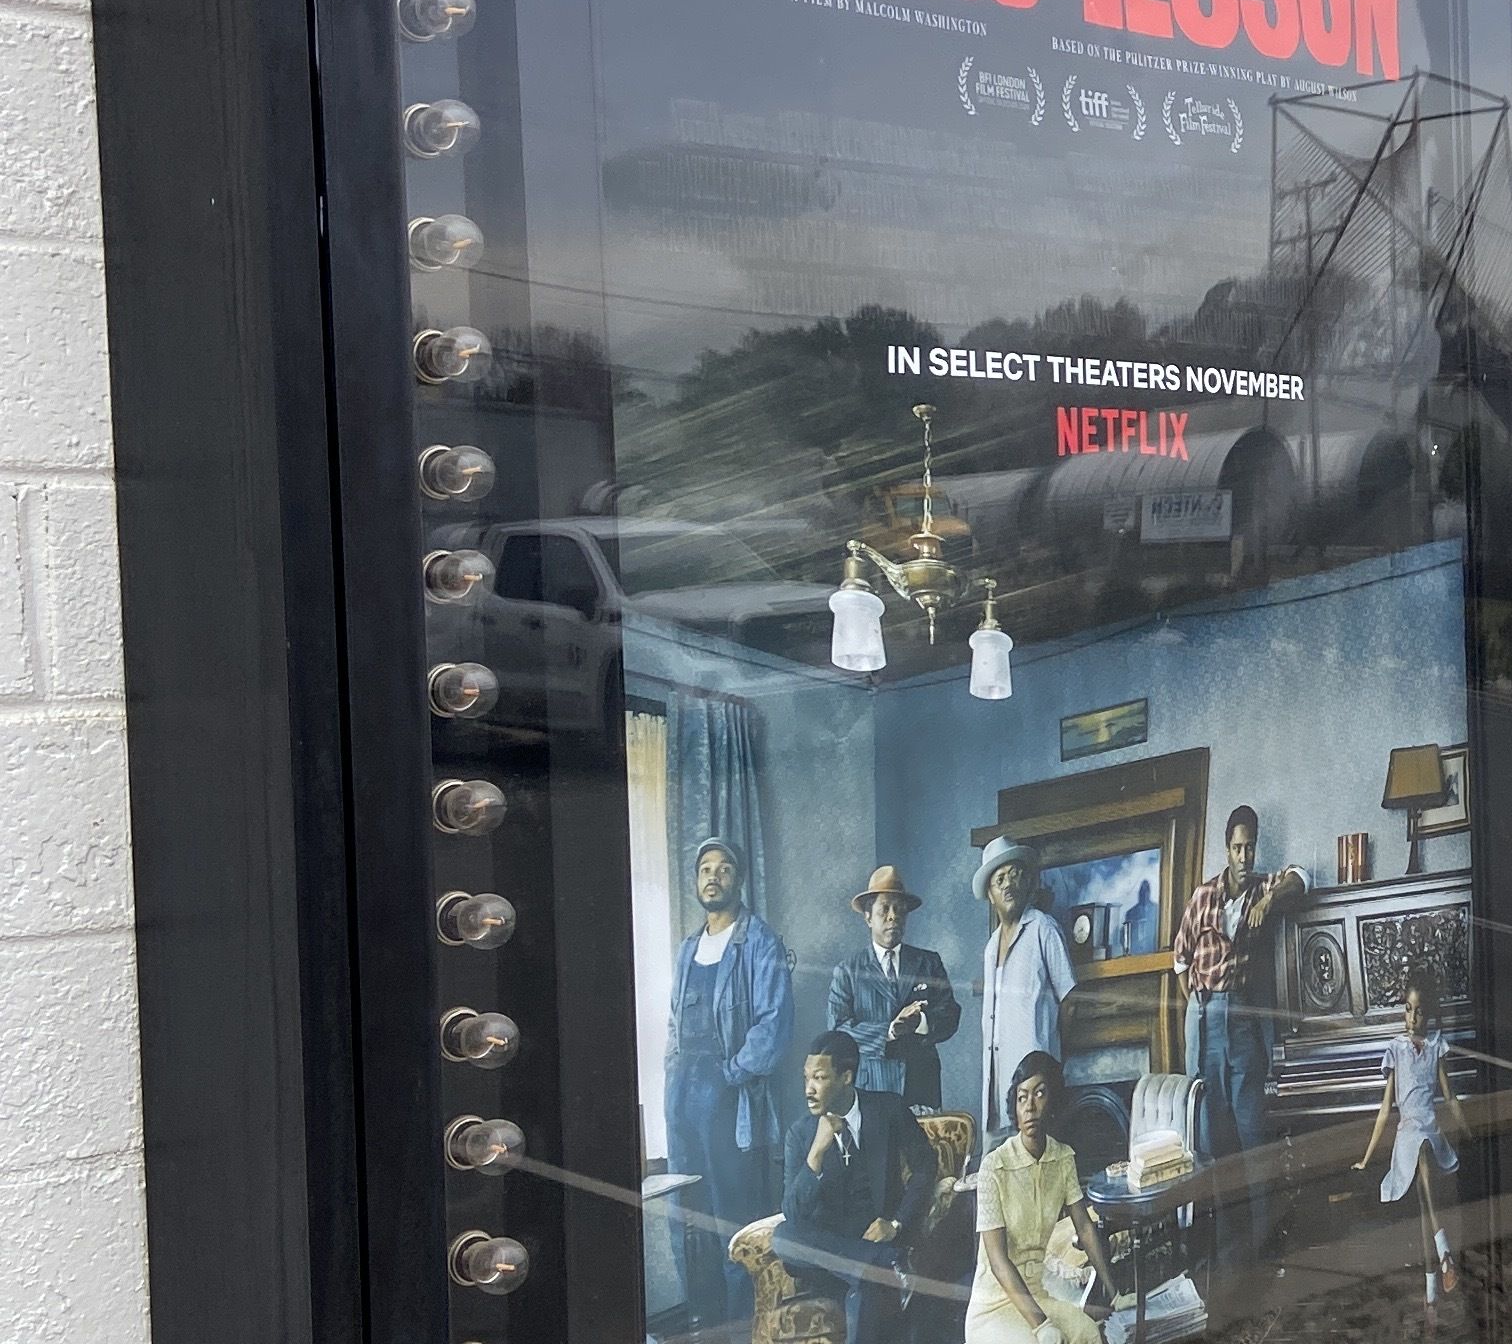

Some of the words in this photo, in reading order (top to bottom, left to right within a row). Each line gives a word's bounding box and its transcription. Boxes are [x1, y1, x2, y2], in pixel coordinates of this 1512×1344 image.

[915, 10, 987, 37] WASHINGTON
[993, 74, 1026, 89] LONDON
[1052, 36, 1084, 54] BASED
[1087, 44, 1100, 57] ON
[1103, 46, 1122, 63] THE
[1125, 51, 1173, 72] PULITZER
[1176, 60, 1253, 82] PRIZE-WINNING
[1256, 71, 1278, 87] PLAY
[1280, 75, 1291, 89] BY
[1294, 79, 1325, 96] AUGUST
[1328, 85, 1357, 103] WILSON
[976, 82, 995, 97] FILM
[996, 86, 1030, 103] FESTIVAL
[1079, 88, 1109, 118] tiff
[888, 345, 921, 376] IN
[929, 347, 1040, 383] SELECT
[1047, 355, 1180, 392] THEATERS
[1186, 366, 1305, 401] NOVEMBER
[1057, 406, 1188, 461] NETFLIX
